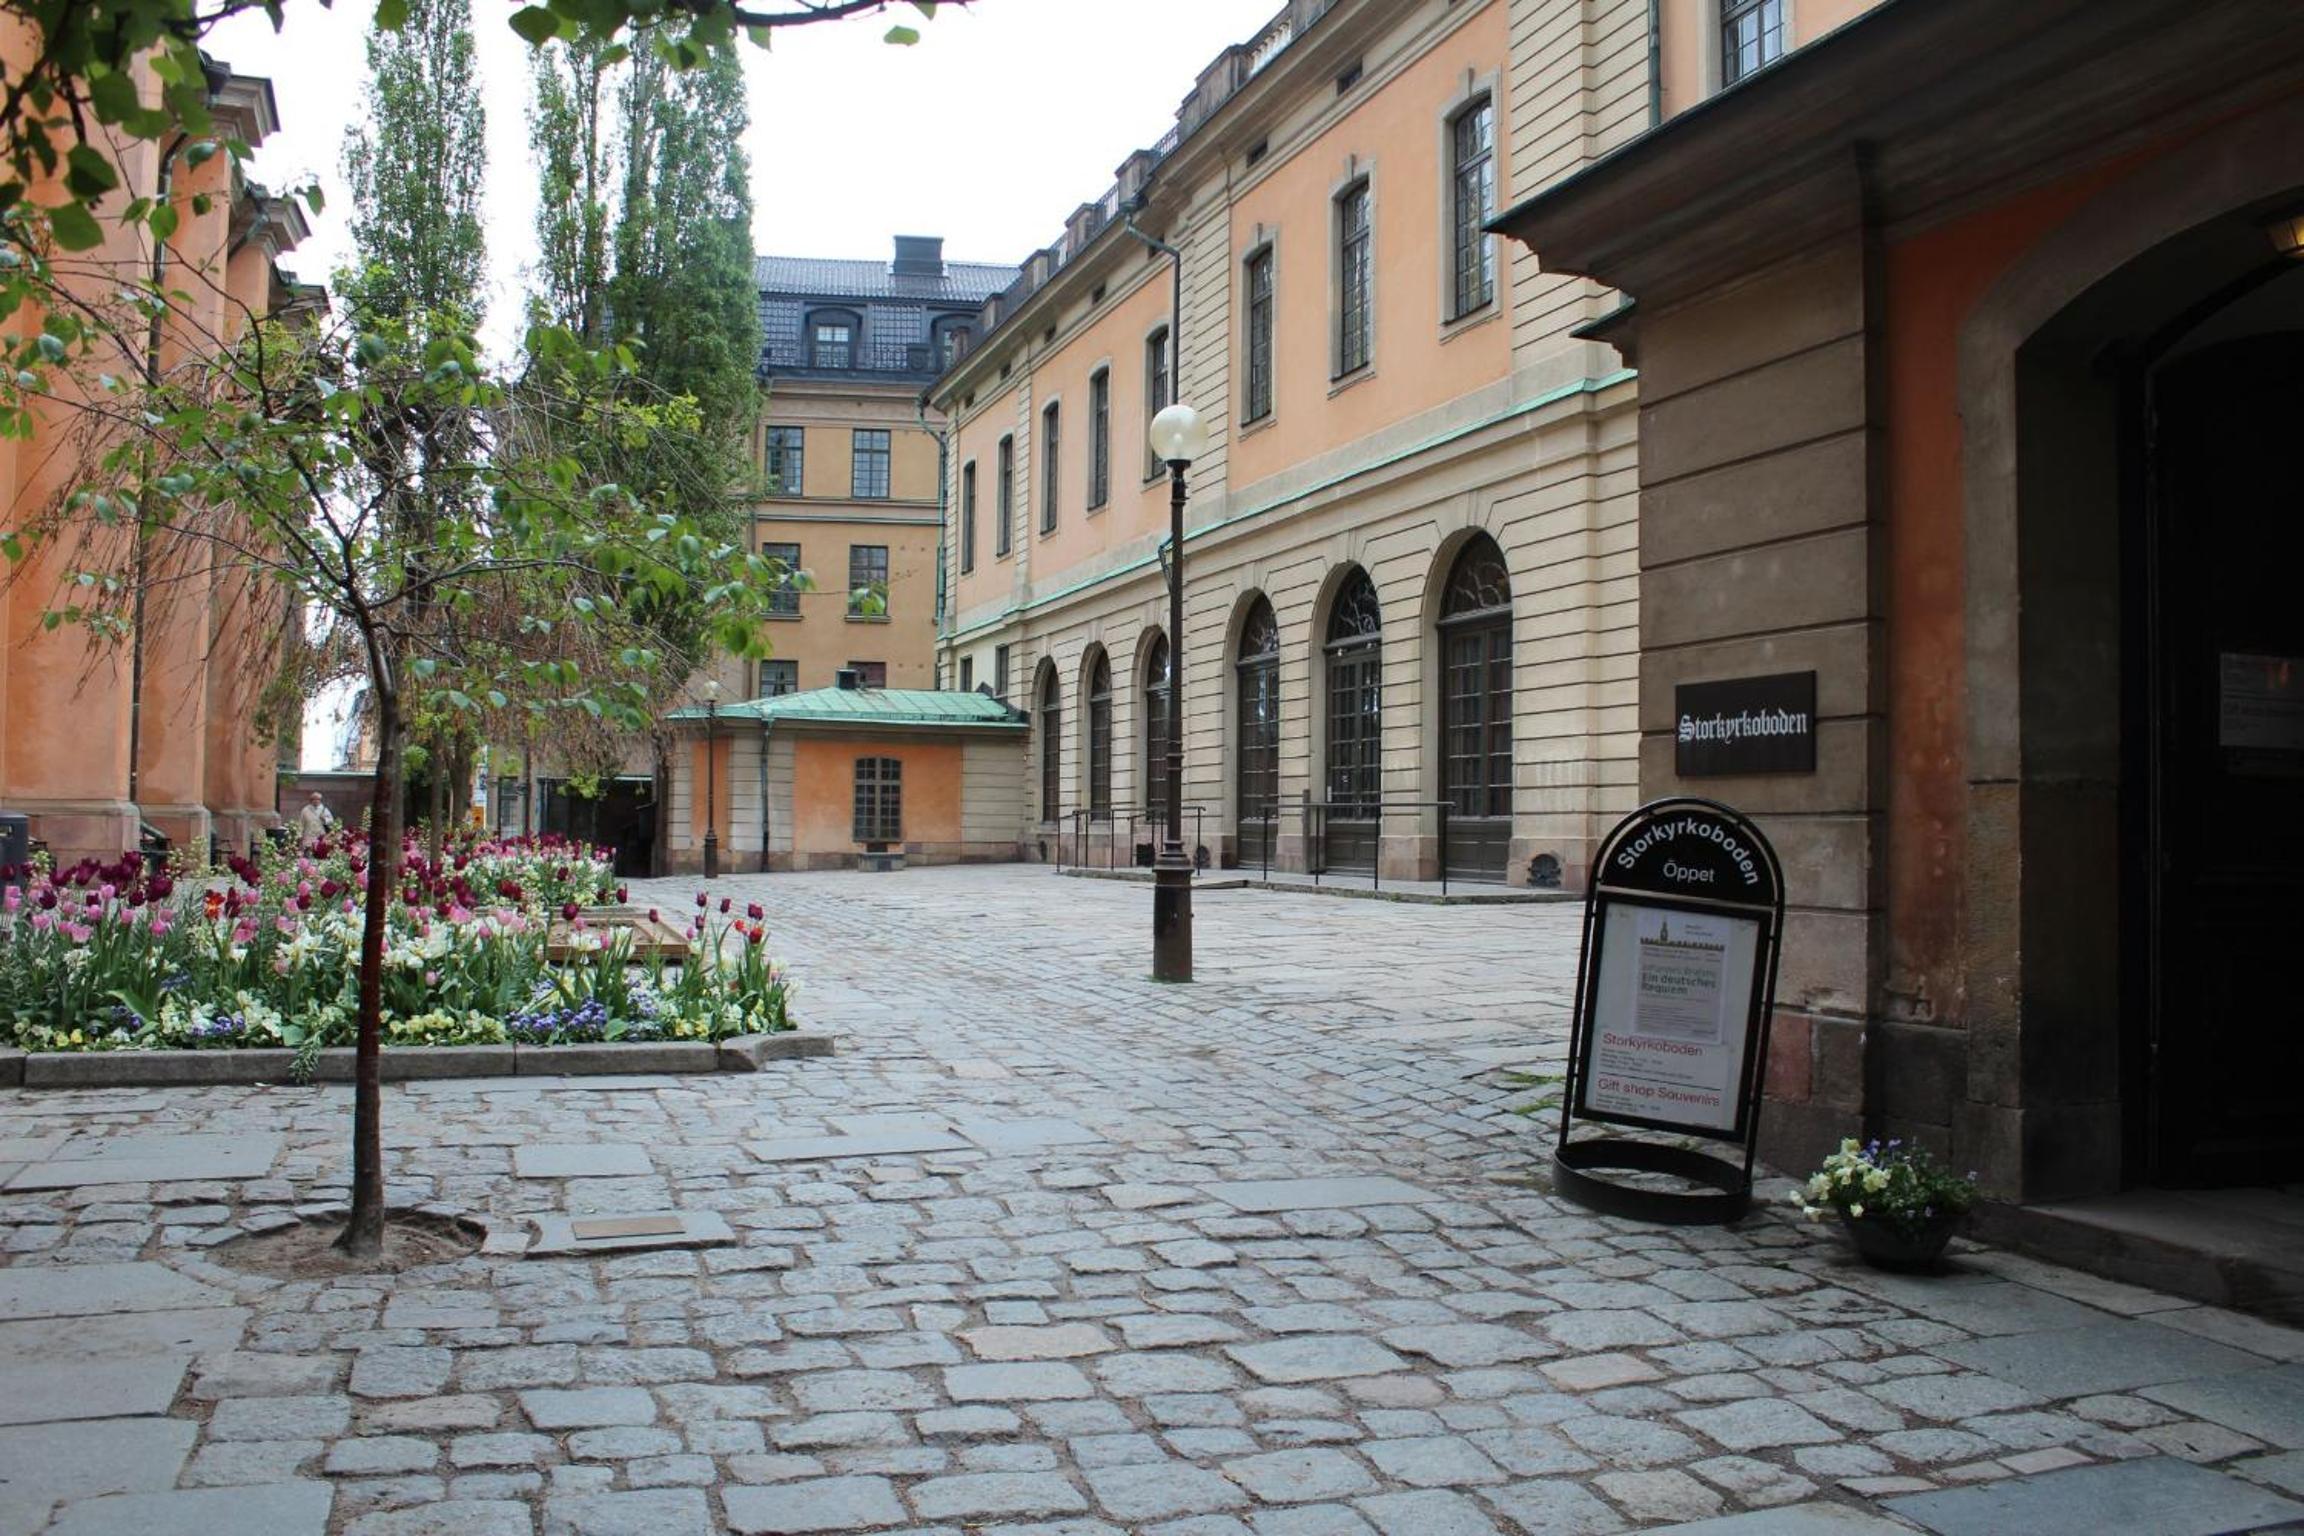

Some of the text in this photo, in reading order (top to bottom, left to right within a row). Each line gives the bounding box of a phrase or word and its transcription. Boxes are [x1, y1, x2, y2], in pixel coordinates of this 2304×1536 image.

[1678, 708, 1808, 744] Storkyrkoboden
[1617, 817, 1759, 885] Storkyrkoboden
[1663, 859, 1716, 884] Öppet
[1603, 1033, 1703, 1056] Storkyrkoboden
[1598, 1079, 1621, 1092] Gift
[1623, 1082, 1655, 1098] shop
[1657, 1087, 1720, 1107] Souvenirs
